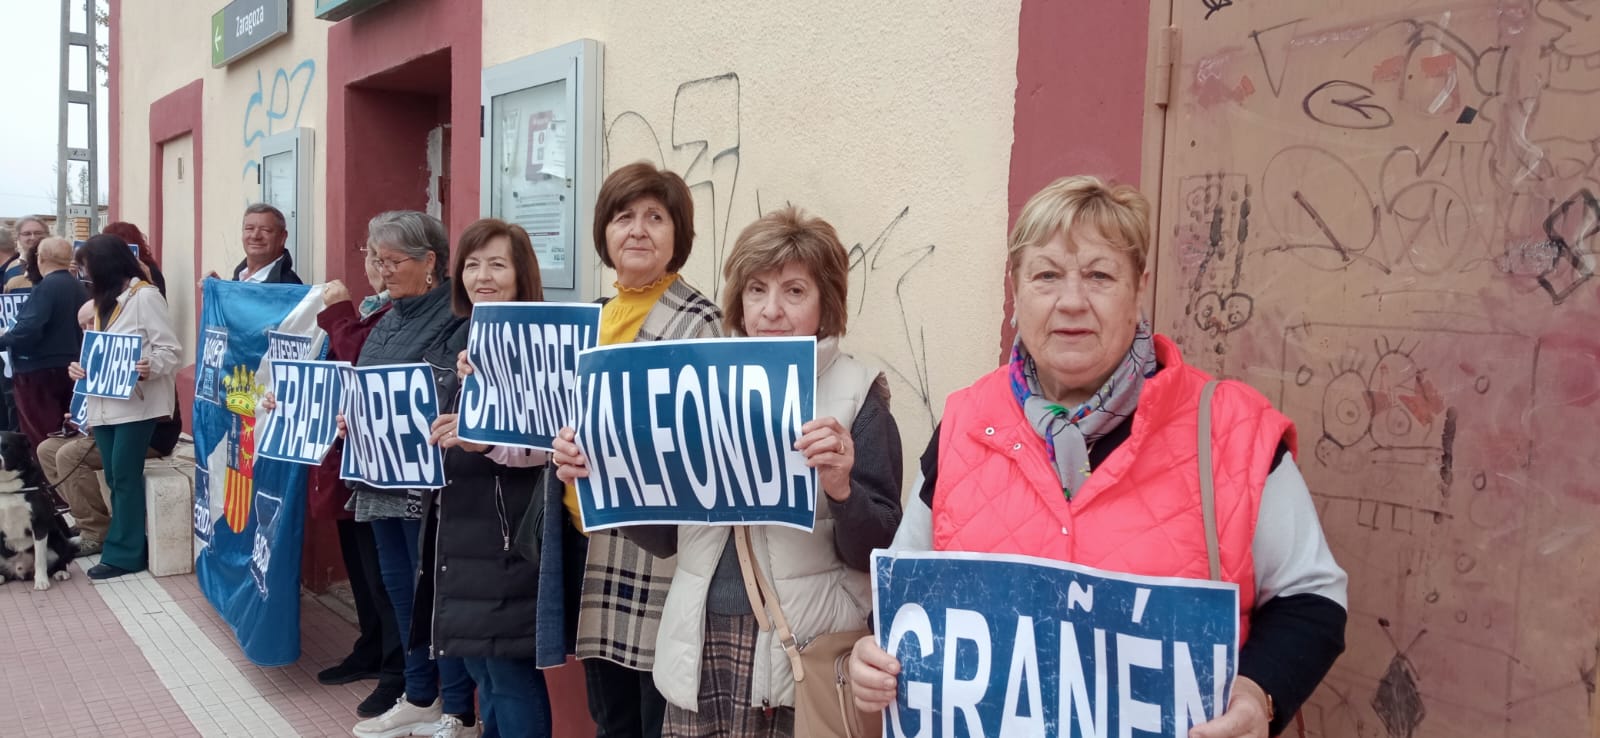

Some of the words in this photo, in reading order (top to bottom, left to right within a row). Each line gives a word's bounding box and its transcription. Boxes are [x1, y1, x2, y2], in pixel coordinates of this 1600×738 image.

[235, 5, 264, 37] Zaragoza
[86, 334, 139, 396] CURBE
[574, 363, 813, 512] VALFONDA
